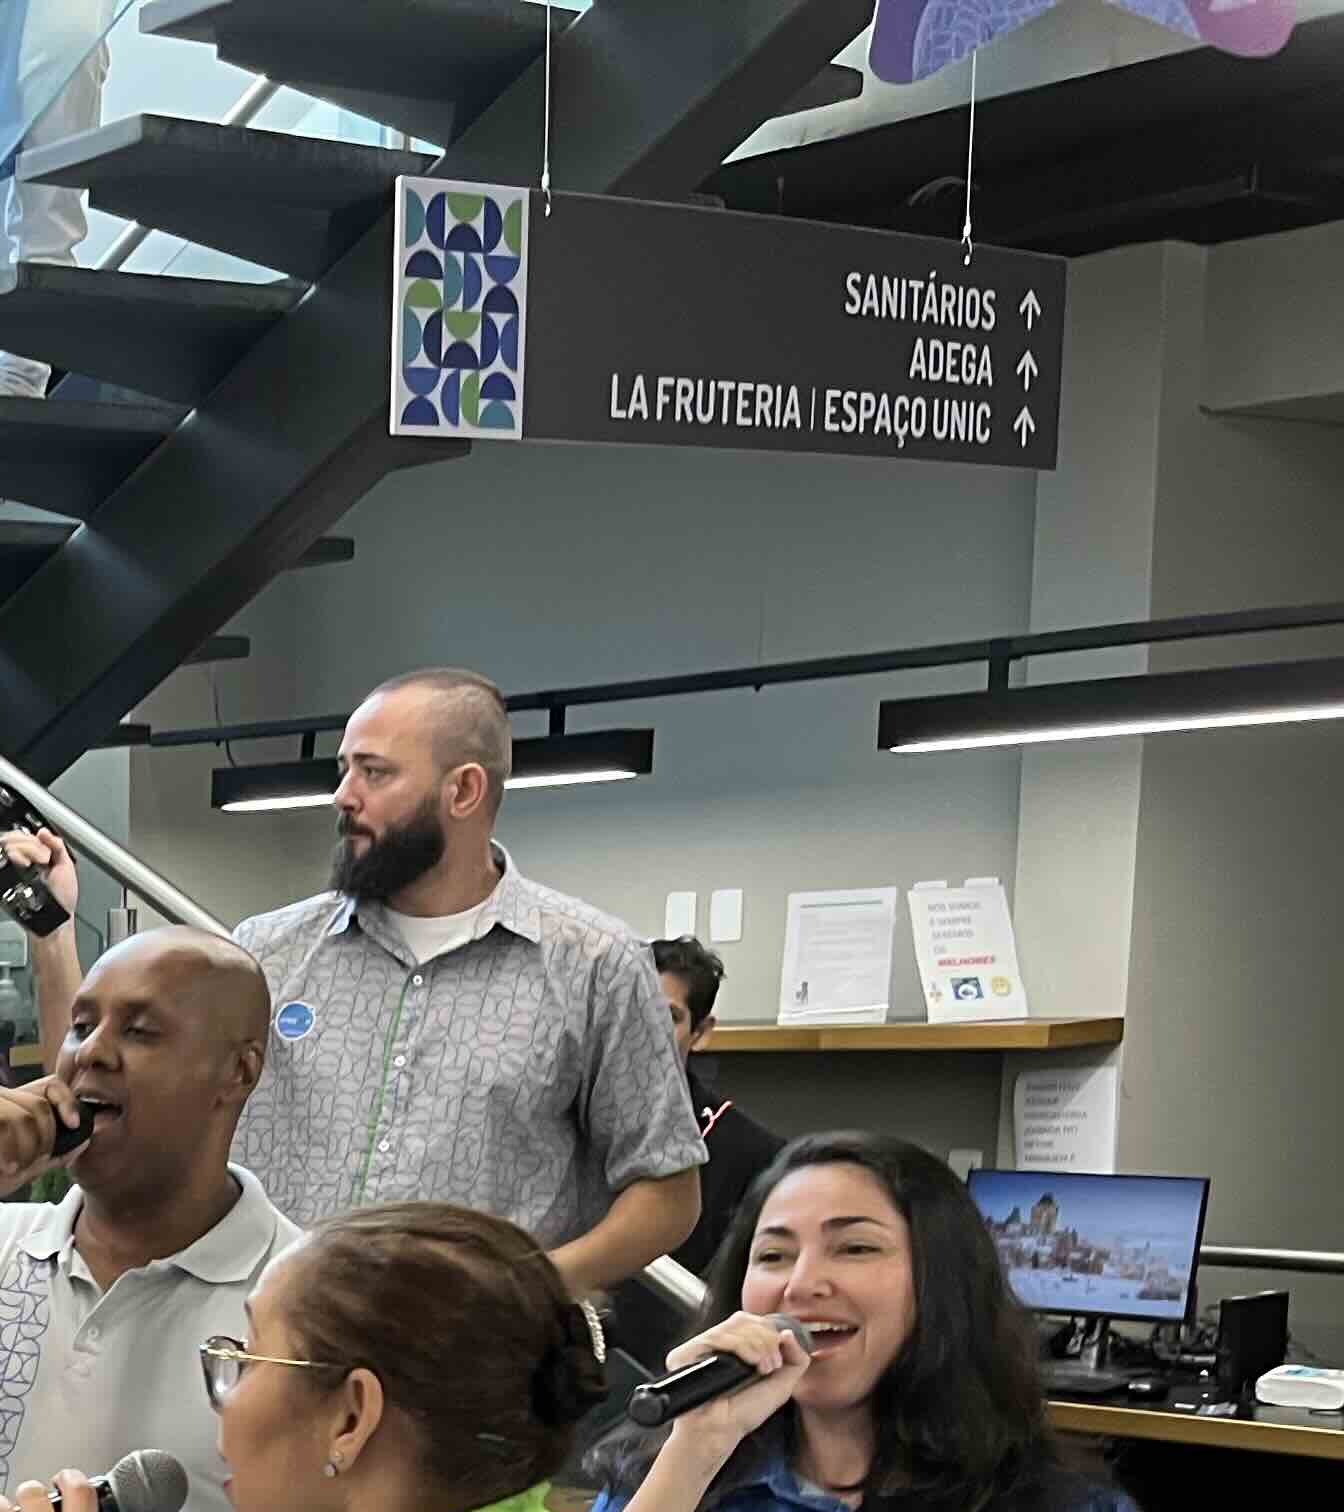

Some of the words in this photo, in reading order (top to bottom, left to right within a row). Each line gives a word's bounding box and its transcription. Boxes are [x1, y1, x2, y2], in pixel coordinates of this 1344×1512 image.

[844, 269, 997, 331] SANITÁRIOS
[909, 336, 994, 388] ADEGA
[610, 372, 649, 421] LA
[655, 375, 802, 430] FRUTERIA
[823, 388, 927, 449] ESPAÇO
[932, 397, 992, 445] UNIC
